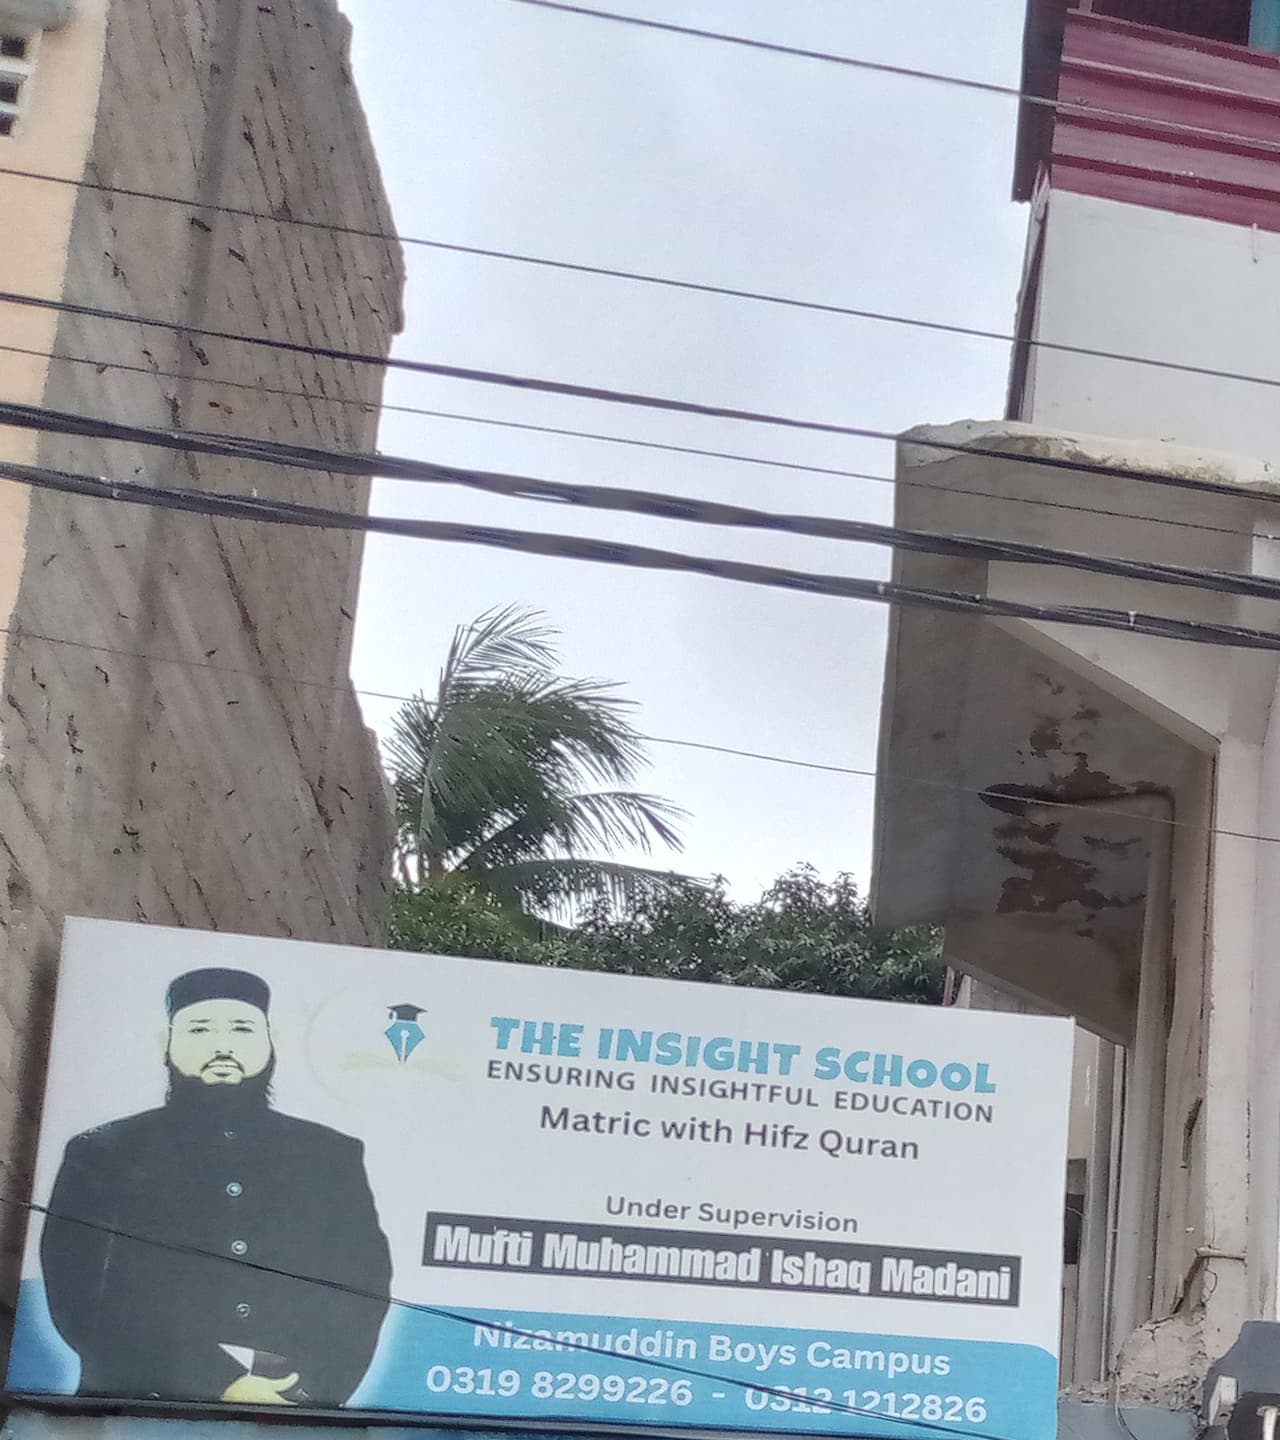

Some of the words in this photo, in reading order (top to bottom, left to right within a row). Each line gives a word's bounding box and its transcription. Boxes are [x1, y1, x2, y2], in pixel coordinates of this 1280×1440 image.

[490, 1016, 584, 1057] THE
[598, 1028, 800, 1075] INSIGHT
[814, 1047, 996, 1093] SCHOOL
[487, 1060, 635, 1091] ENSURING
[651, 1075, 819, 1107] INSIGHTFUL
[834, 1091, 993, 1123] EDUCATION
[540, 1106, 650, 1136] Matric
[661, 1117, 732, 1143] with
[744, 1122, 809, 1149] Hifz
[819, 1129, 919, 1159] Quran
[606, 1195, 690, 1219] Under
[699, 1203, 858, 1233] Supervision
[433, 1223, 532, 1266] Mufti
[542, 1232, 761, 1283] Muhammad
[770, 1249, 872, 1294] Ishaq
[880, 1257, 1011, 1300] Madani
[474, 1321, 697, 1360] Nizamuddin
[709, 1335, 797, 1370] Boys
[807, 1341, 950, 1378] Campus
[426, 1365, 520, 1396] 0319
[531, 1371, 693, 1407] 8299226
[745, 1385, 832, 1414] 0312
[842, 1389, 987, 1423] 1212826
